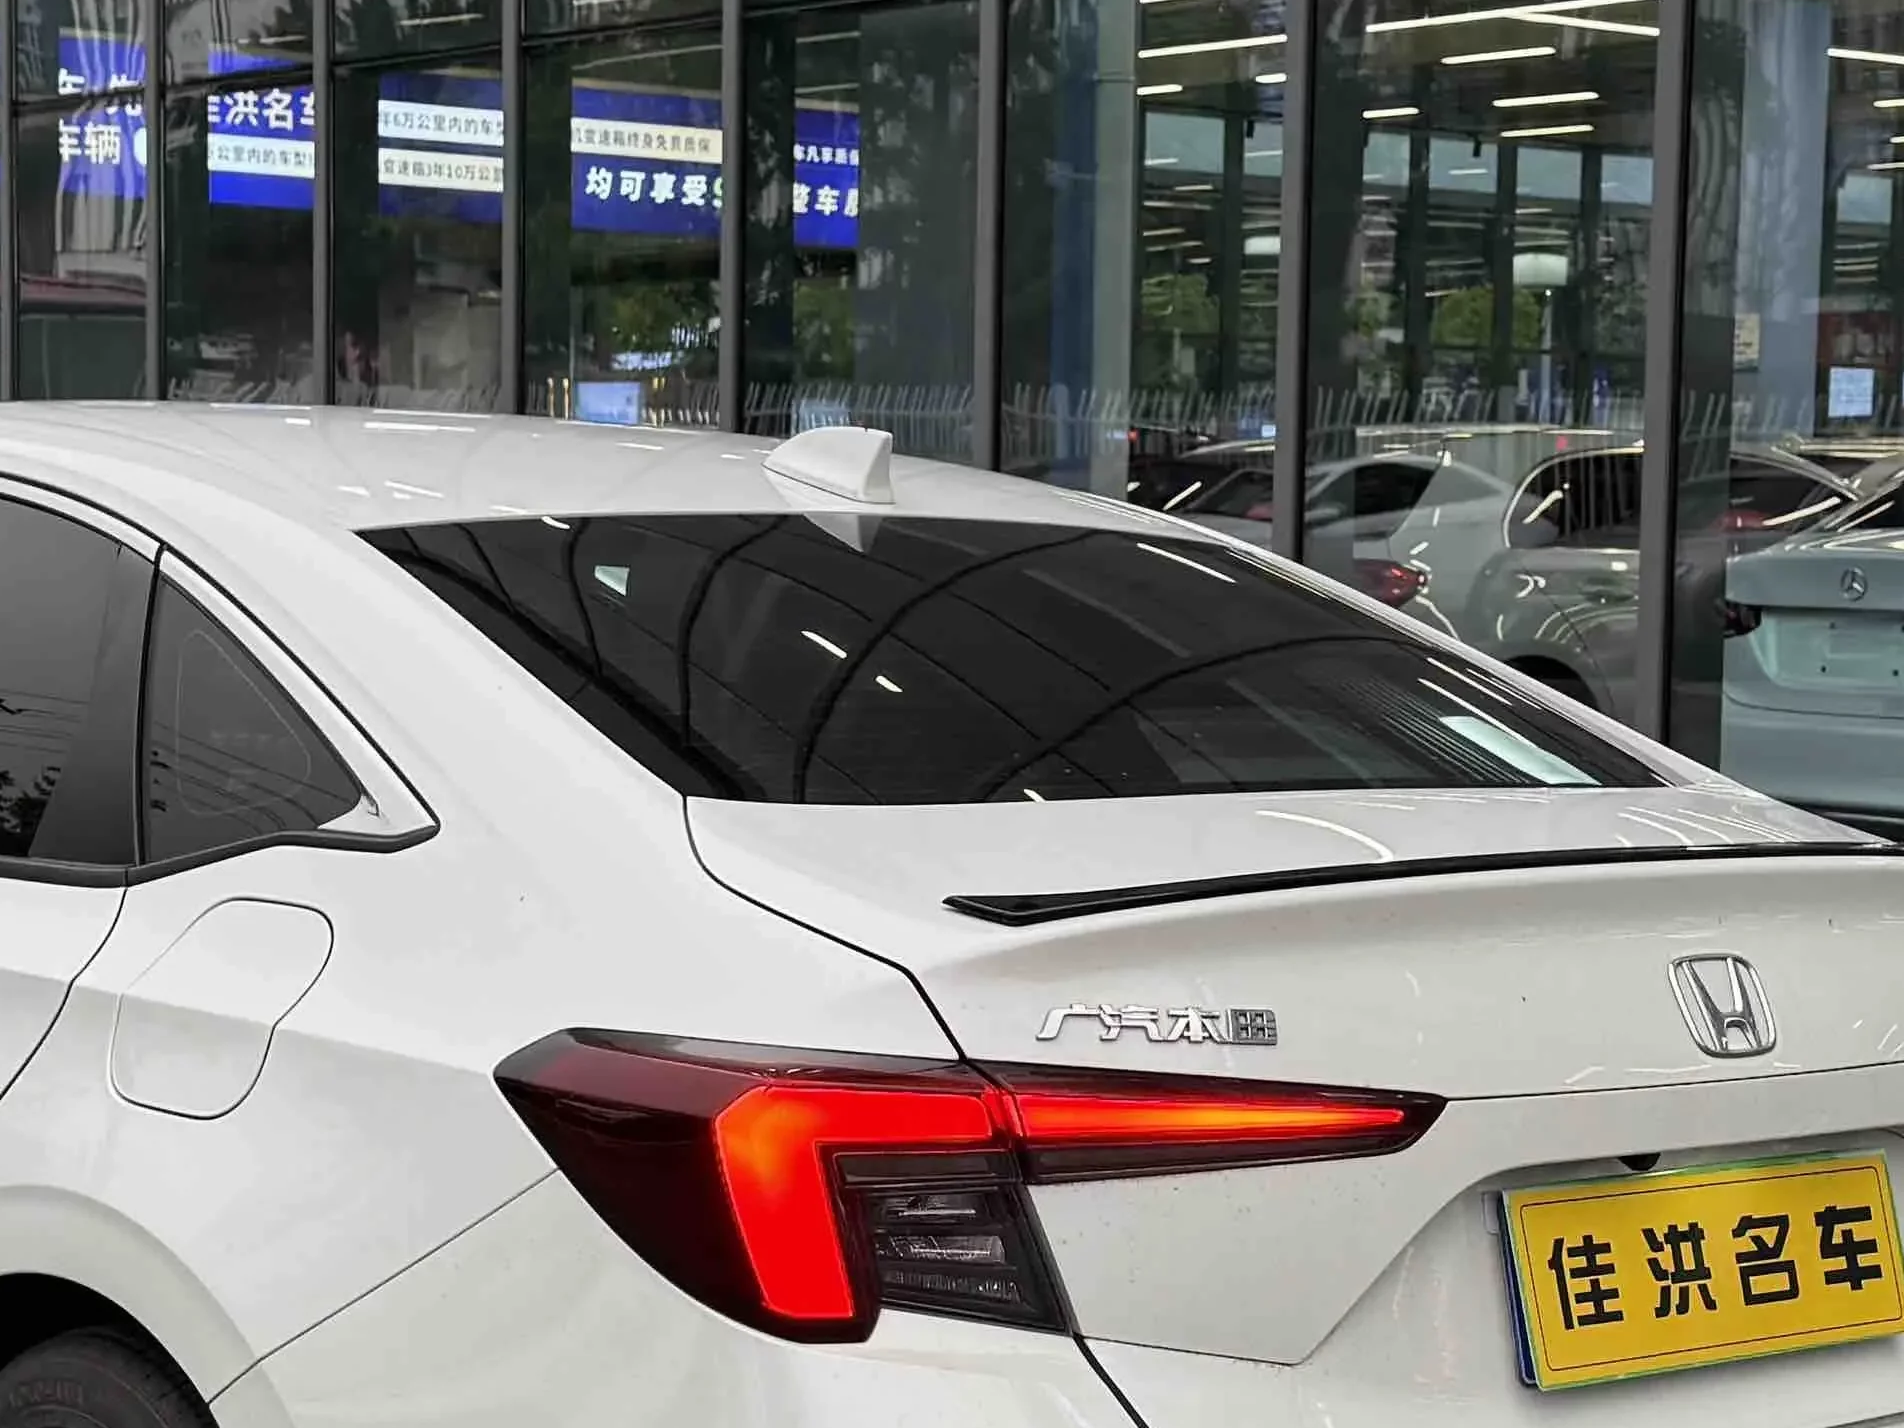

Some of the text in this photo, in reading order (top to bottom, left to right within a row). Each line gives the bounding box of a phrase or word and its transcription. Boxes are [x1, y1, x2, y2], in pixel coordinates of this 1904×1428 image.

[1035, 1003, 1279, 1046] 广汽本田
[1547, 1205, 1884, 1332] 佳洪名车
